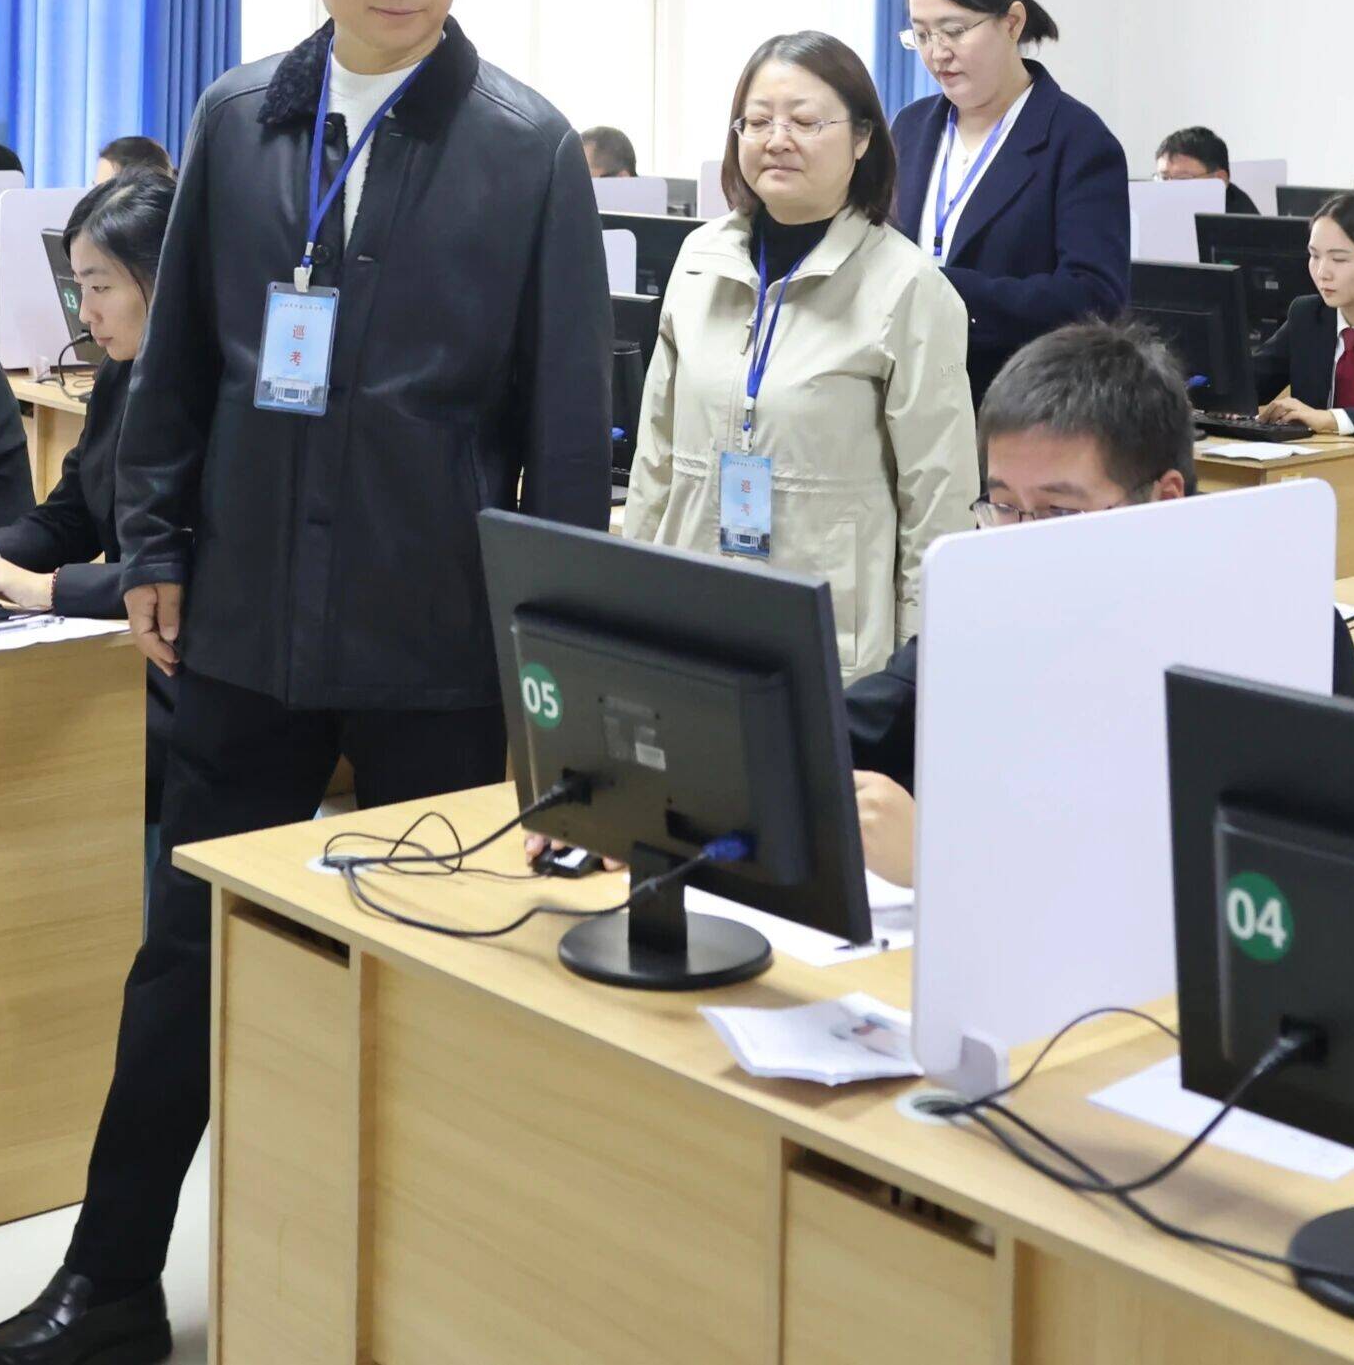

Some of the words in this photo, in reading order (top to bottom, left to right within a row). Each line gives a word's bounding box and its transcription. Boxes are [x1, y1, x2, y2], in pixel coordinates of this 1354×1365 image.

[63, 291, 78, 310] 13
[522, 676, 560, 719] 05
[1226, 887, 1288, 950] 04
